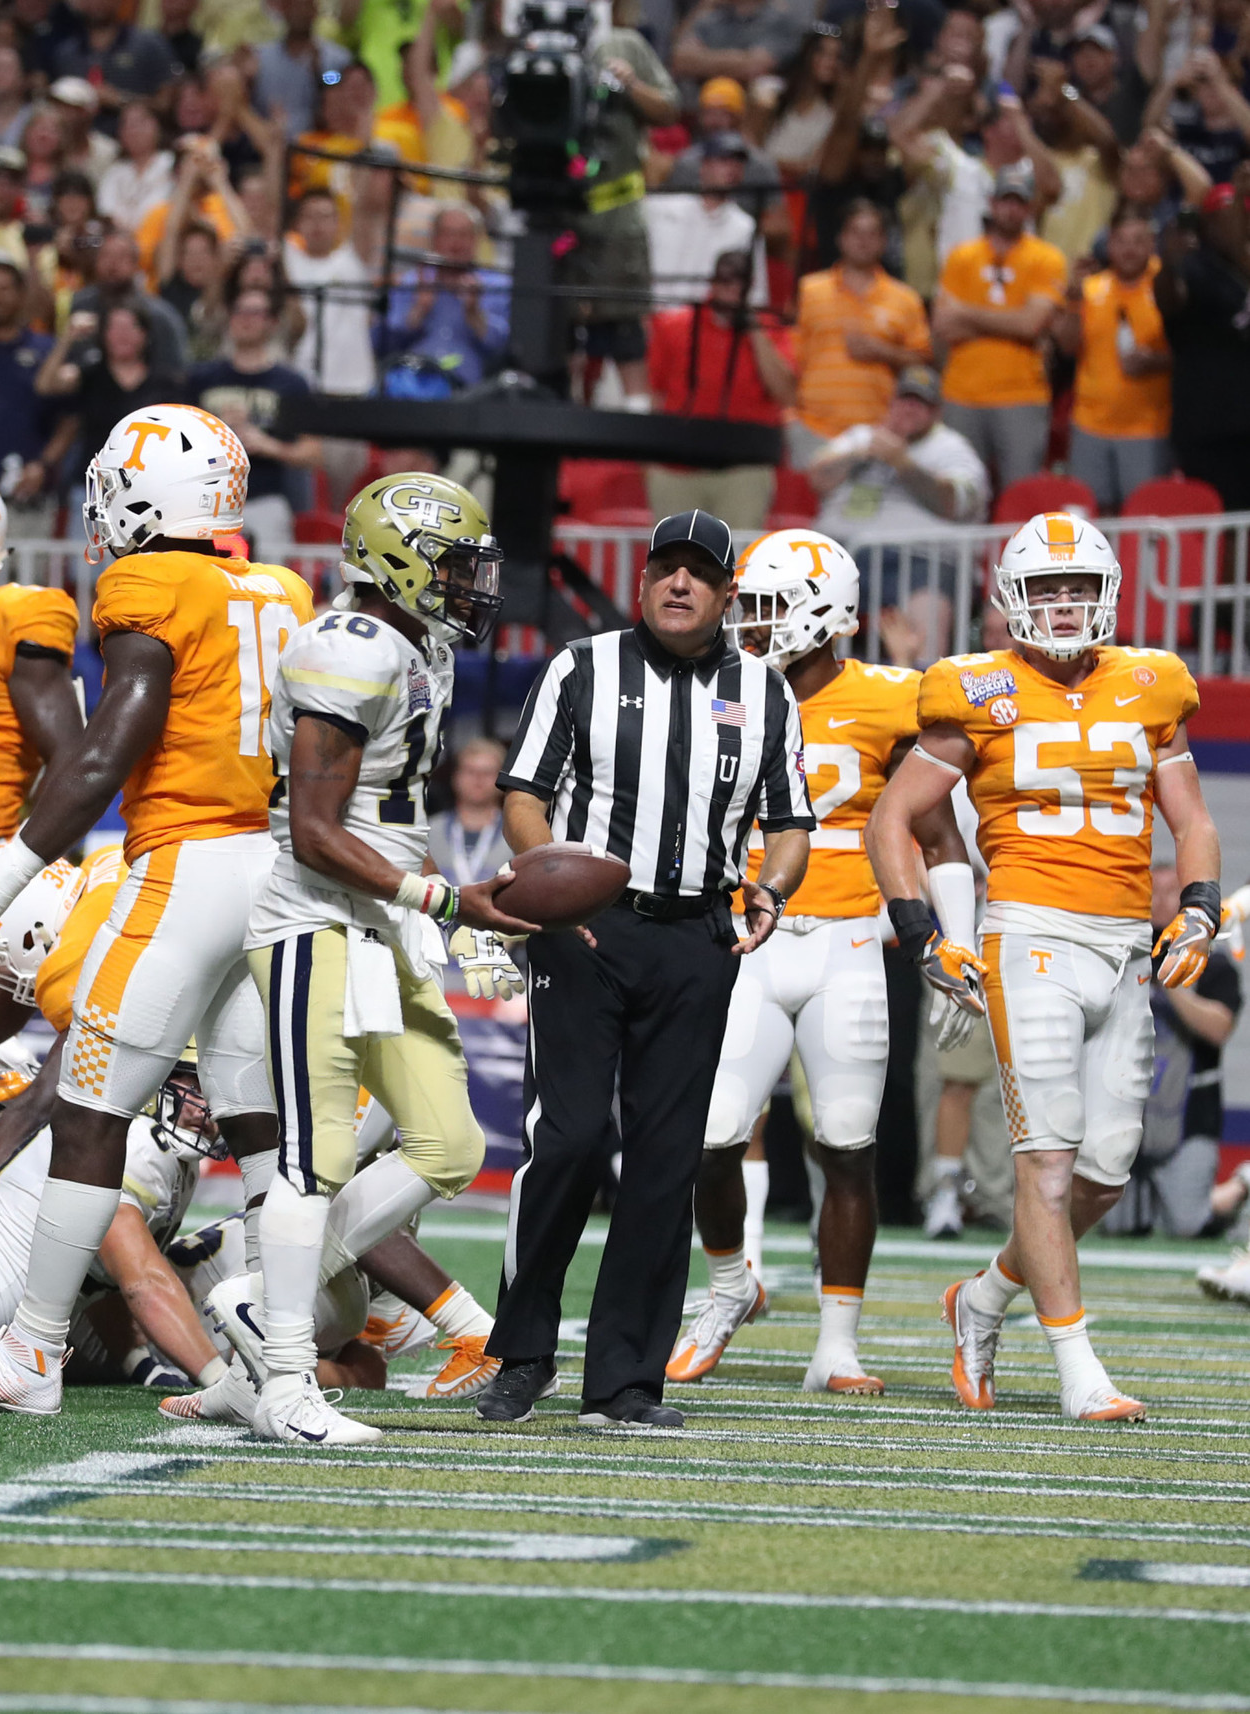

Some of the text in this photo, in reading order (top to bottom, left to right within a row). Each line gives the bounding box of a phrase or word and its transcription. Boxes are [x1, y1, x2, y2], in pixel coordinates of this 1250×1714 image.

[123, 422, 172, 471] T
[381, 483, 462, 530] GT
[789, 541, 833, 579] T
[991, 698, 1018, 725] SEC
[1066, 693, 1084, 710] T
[719, 754, 739, 783] U
[1013, 720, 1153, 837] 53
[1030, 950, 1052, 974] T
